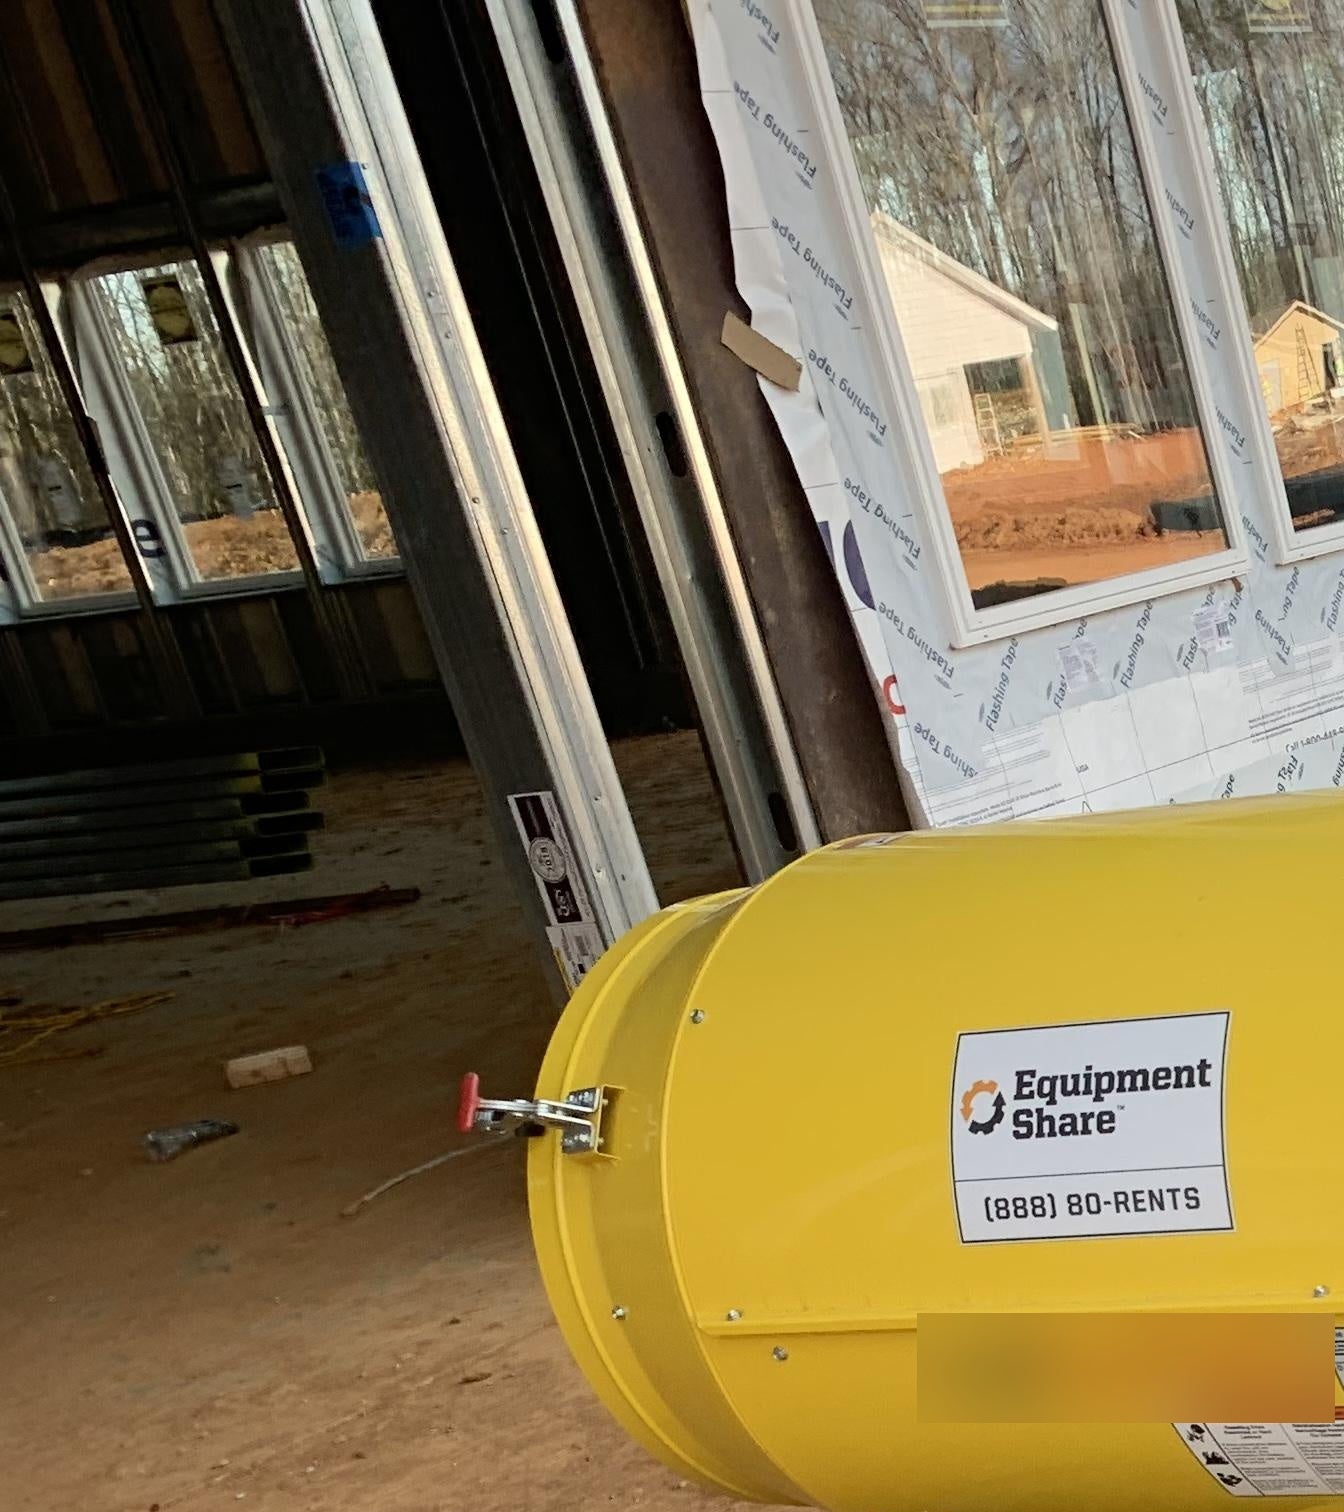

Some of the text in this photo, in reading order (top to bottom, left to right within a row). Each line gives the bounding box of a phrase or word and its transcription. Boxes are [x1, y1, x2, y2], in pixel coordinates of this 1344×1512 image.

[733, 81, 818, 179] Flashing Tape
[770, 216, 854, 311] Flashing Tape
[807, 347, 888, 437] Flashing Tape
[842, 475, 922, 560] Flashing Tape
[877, 601, 956, 679] Flashing Tape
[1119, 600, 1154, 690] Flashing Tape
[985, 637, 1019, 733] Flashing Tape
[913, 721, 942, 764] Tape
[1013, 1058, 1212, 1106] Equipment
[985, 1187, 1202, 1222] (888) 80-RENTS
